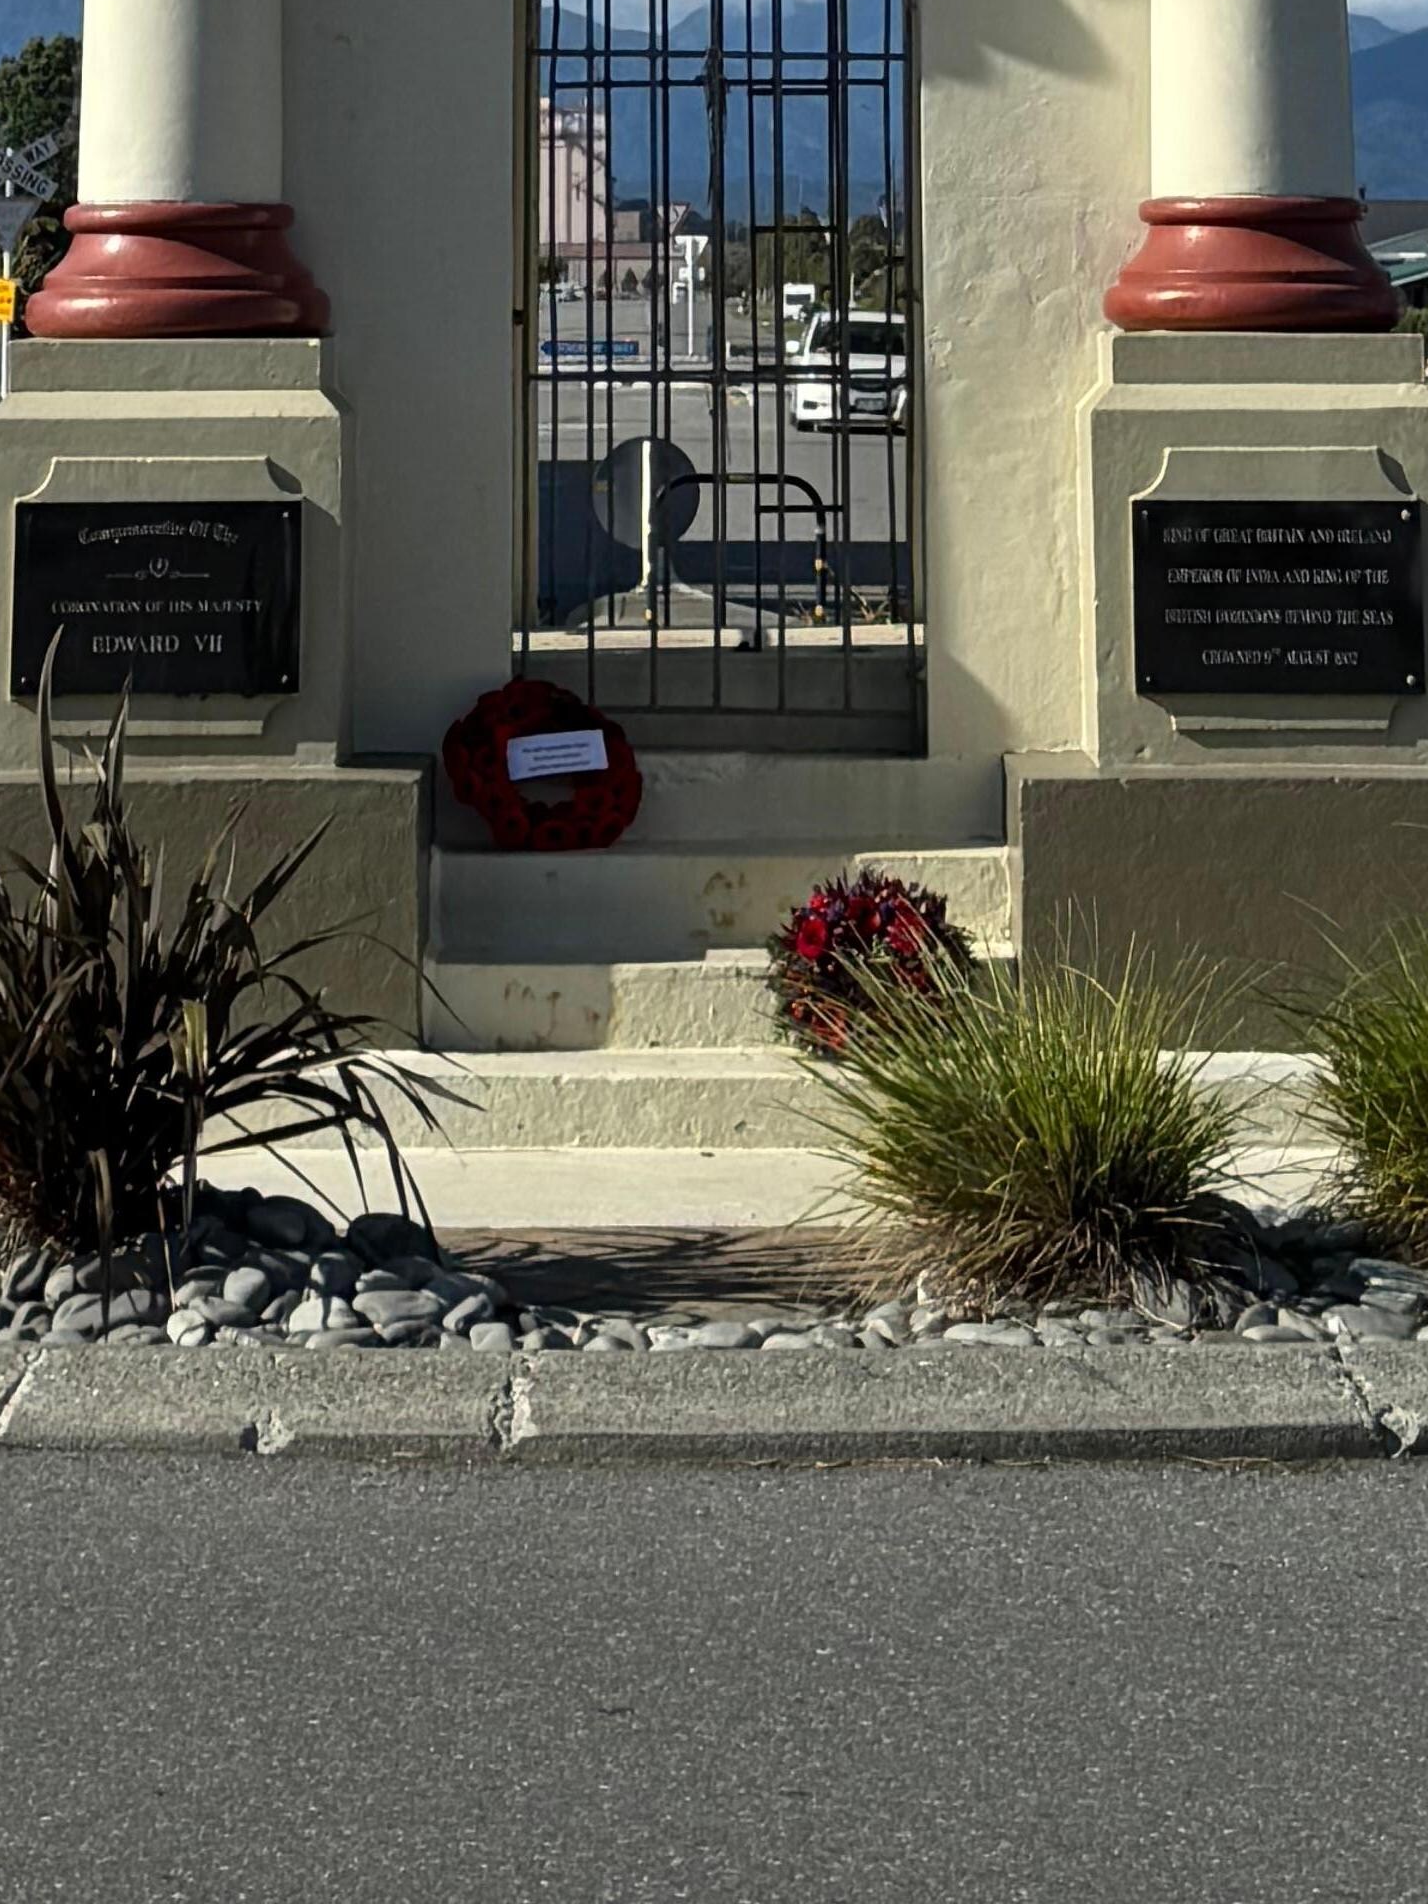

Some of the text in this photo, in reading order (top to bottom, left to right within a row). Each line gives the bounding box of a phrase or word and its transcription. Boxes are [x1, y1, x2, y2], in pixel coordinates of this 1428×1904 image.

[1310, 528, 1336, 543] AND
[1246, 568, 1280, 585] INDIA
[1283, 568, 1310, 585] AND
[1365, 568, 1390, 585] THE
[51, 599, 262, 614] CORONATION OF HIS MAJESTY
[1335, 608, 1359, 625] THE
[1362, 608, 1394, 625] SEAS
[92, 633, 223, 654] EDWARD VII
